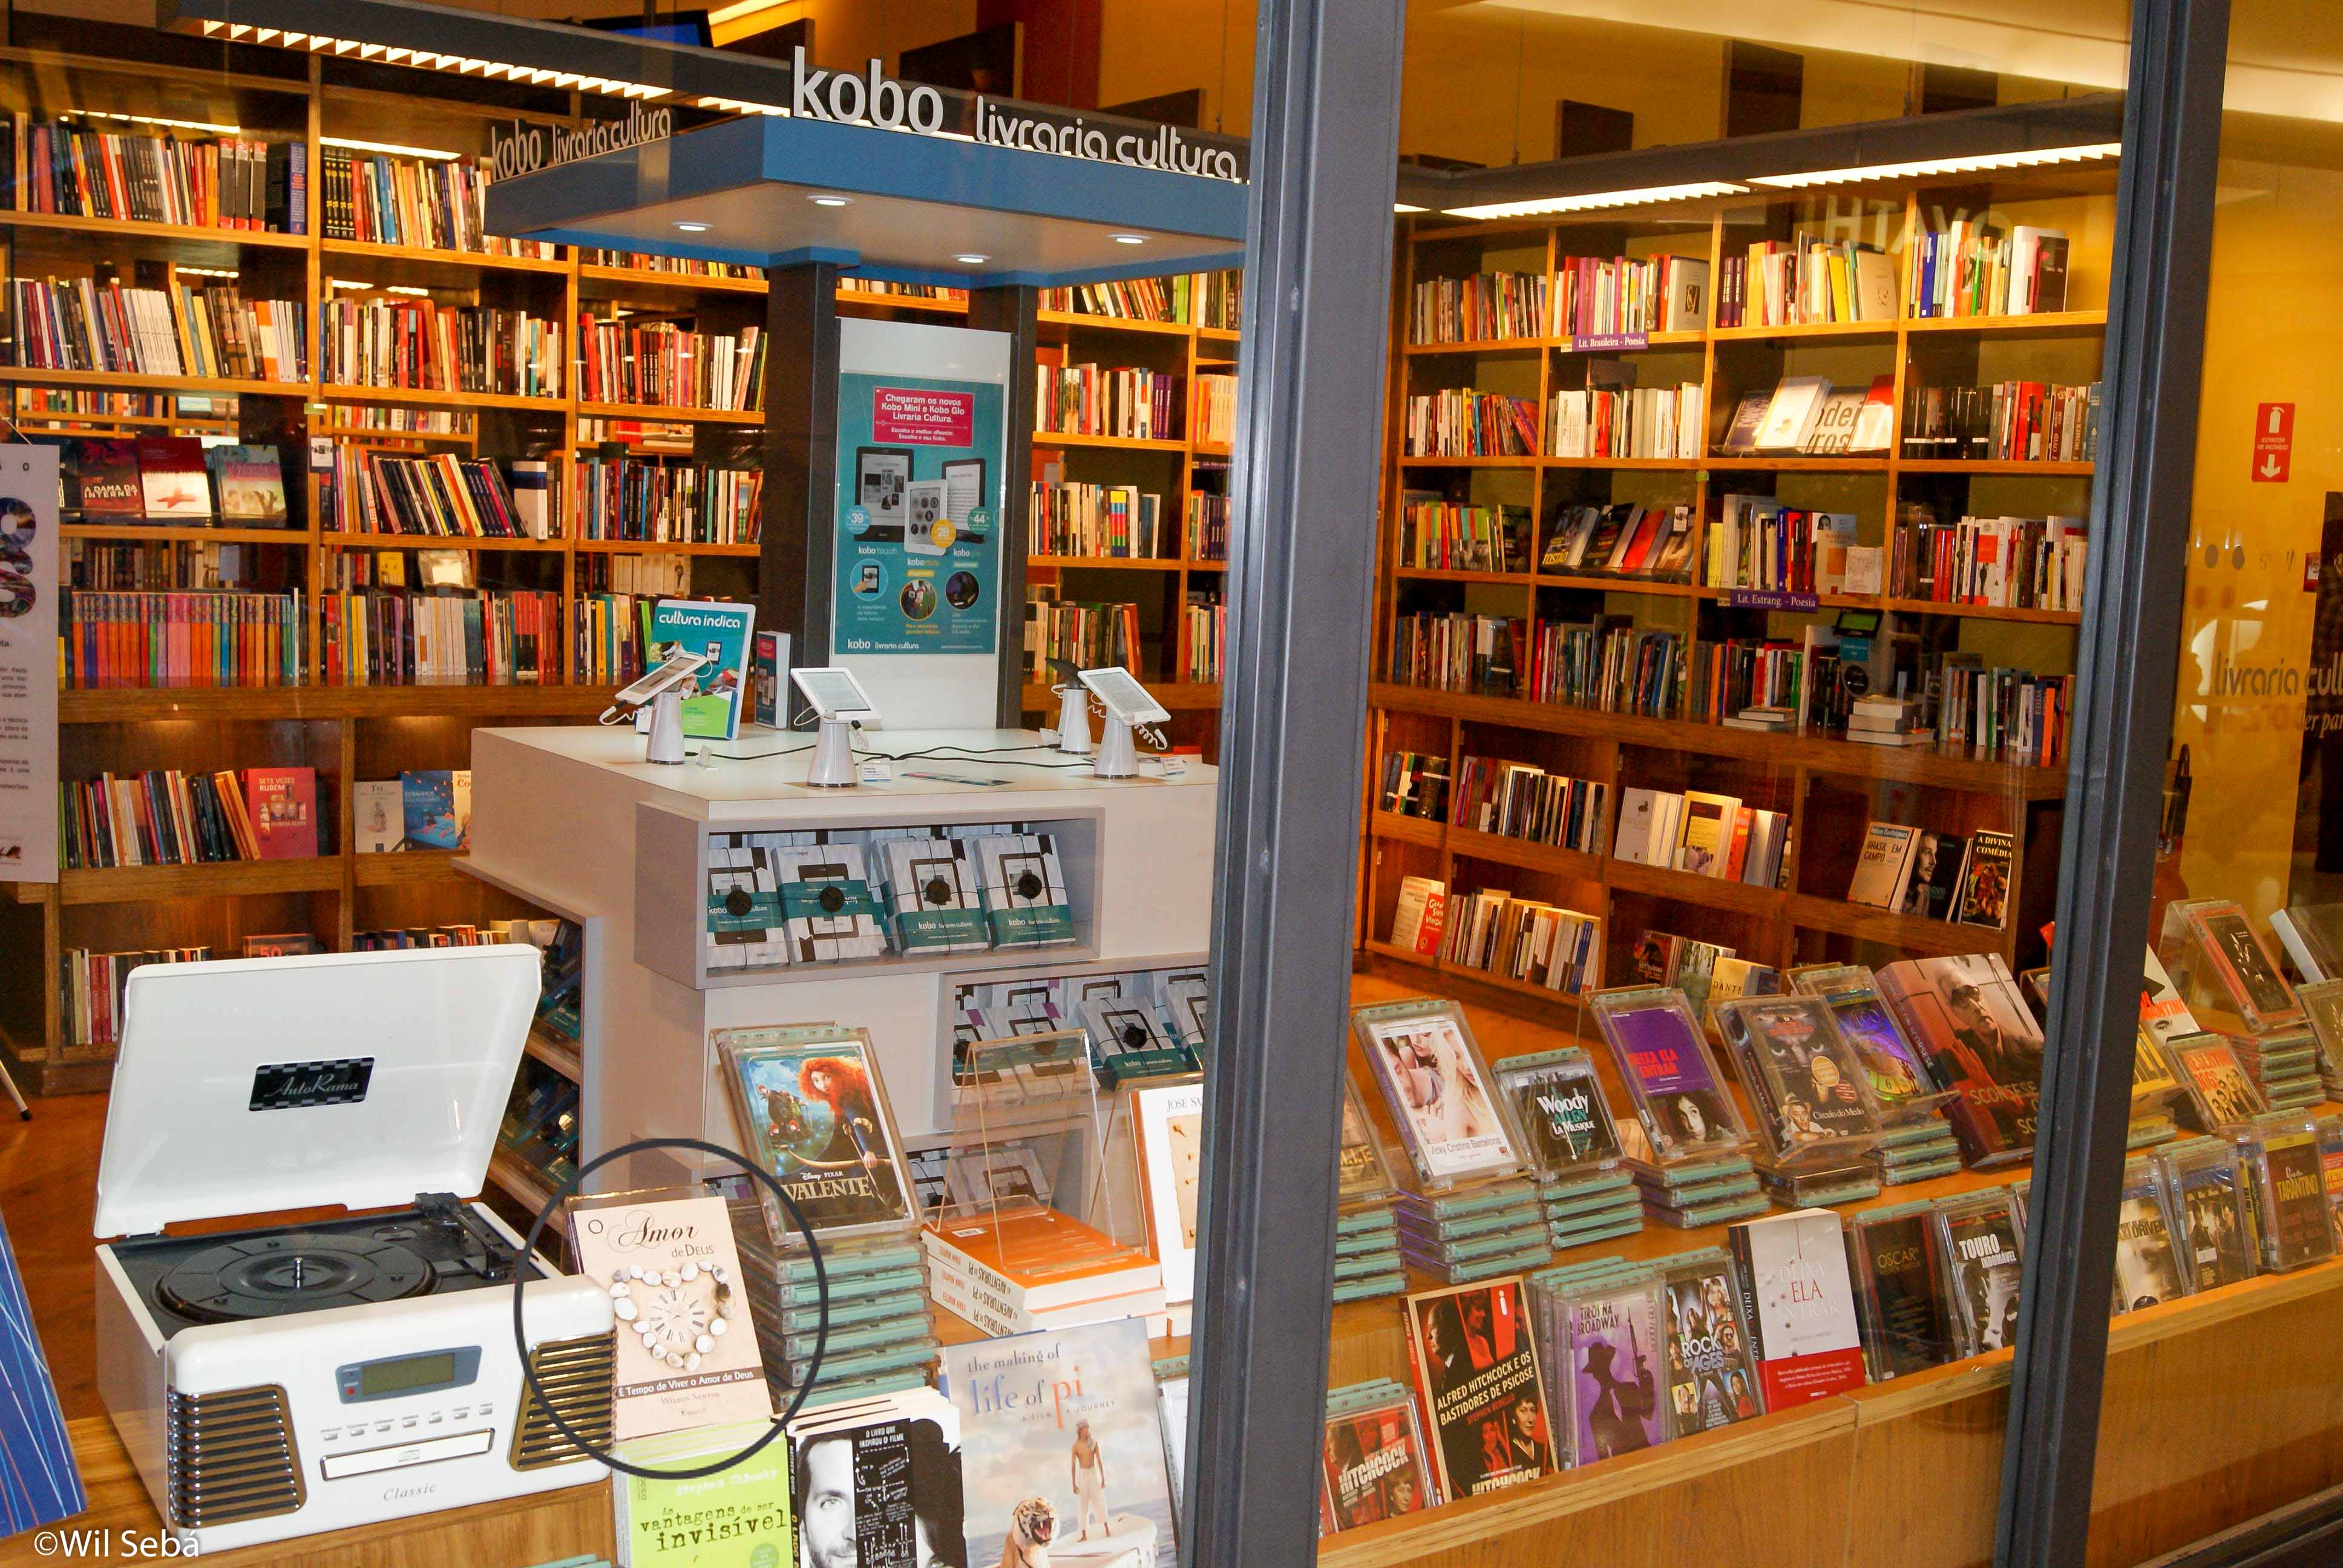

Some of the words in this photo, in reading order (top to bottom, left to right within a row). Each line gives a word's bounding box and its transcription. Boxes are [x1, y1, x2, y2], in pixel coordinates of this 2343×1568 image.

[794, 45, 943, 135] kobo
[977, 95, 1107, 160] livraria
[1116, 125, 1237, 178] cultura
[492, 119, 541, 181] kobo
[552, 119, 606, 164] livraria
[611, 100, 670, 149] cultura
[1578, 338, 1589, 347] Lit.
[1590, 337, 1619, 347] Brasileira
[1624, 336, 1645, 346] Poesia
[885, 394, 925, 404] Chegaram
[882, 402, 902, 411] Kobo
[904, 403, 920, 412] Mini
[929, 405, 949, 414] Kobo
[951, 406, 965, 415] Glo
[893, 412, 921, 421] Livraria
[923, 413, 954, 423] Cultura.
[84, 489, 139, 498] INTERNET
[93, 485, 122, 493] DAMA
[851, 513, 864, 523] 39
[973, 515, 985, 524] 44
[938, 528, 949, 536] 28
[1738, 594, 1750, 604] Lit.
[1752, 595, 1783, 607] Estrang.
[1791, 596, 1815, 607] Poesia
[659, 610, 701, 626] cultura
[703, 615, 741, 629] indica
[848, 639, 871, 649] kobo
[2215, 650, 2298, 696] livraria
[1867, 841, 1887, 852] BRASIL
[1985, 837, 2012, 848] DIVINA
[1863, 851, 1886, 863] CAMPO
[1976, 845, 2013, 858] COMÉDIA
[709, 906, 727, 914] kobo
[918, 921, 937, 930] kobo
[1712, 981, 1743, 996] DANTE
[1123, 1059, 1141, 1067] kobo
[1660, 1048, 1679, 1062] ELA
[263, 1074, 359, 1097] AutoRama
[1970, 1080, 2038, 1105] SCORSESE
[1165, 1097, 1188, 1111] JOSÉ
[1537, 1088, 1588, 1115] Woody
[1554, 1111, 1587, 1124] ALLEN
[1845, 1106, 1864, 1117] Medo
[800, 1172, 822, 1181] Disney
[824, 1170, 844, 1179] PIXAR
[782, 1175, 874, 1203] VALENTE
[2276, 1174, 2319, 1202] TARANTINO
[588, 1219, 604, 1234] O
[607, 1209, 701, 1253] Amor
[672, 1247, 684, 1258] de
[685, 1244, 714, 1257] DEUS
[1959, 1233, 2000, 1261] TOURO
[1878, 1248, 1916, 1269] OSCAR
[1981, 1250, 2017, 1269] INDOMÁVEL
[968, 1261, 974, 1275] PI
[978, 1267, 1007, 1295] AVENTURAS
[972, 1285, 979, 1301] PI
[1791, 1279, 1823, 1302] ELA
[983, 1292, 1014, 1319] AVENTURAS
[1580, 1306, 1601, 1320] TIROS
[1602, 1303, 1613, 1315] NA
[1743, 1292, 1754, 1321] DEIXA
[974, 1308, 979, 1322] PI
[1682, 1336, 1721, 1359] ROCK
[968, 1357, 990, 1373] the
[994, 1348, 1044, 1368] making
[1047, 1342, 1061, 1359] of
[1693, 1352, 1725, 1373] AGES
[618, 1385, 624, 1397] É
[626, 1384, 655, 1396] Tempo
[657, 1382, 667, 1391] de
[667, 1379, 689, 1390] Viver
[698, 1374, 721, 1386] Amor
[723, 1373, 733, 1383] de
[734, 1370, 754, 1380] Deus
[1437, 1385, 1467, 1410] ALFRED
[1469, 1363, 1513, 1393] HITCHCOCK
[1513, 1358, 1520, 1369] E
[1521, 1351, 1531, 1365] OS
[971, 1374, 1018, 1415] life
[1026, 1379, 1045, 1406] of
[1052, 1365, 1084, 1428] pi
[1440, 1393, 1489, 1426] BASTIDORES
[1490, 1386, 1501, 1399] DE
[1502, 1367, 1535, 1394] PSICOSE
[1030, 1412, 1052, 1421] FILM
[1075, 1399, 1116, 1414] JOURNEY
[1466, 1405, 1491, 1425] STEPHEN
[859, 1436, 882, 1448] INSPIROU
[883, 1436, 889, 1445] O
[889, 1432, 905, 1443] FILME
[865, 1429, 870, 1439] O
[871, 1426, 885, 1437] LIVRO
[885, 1425, 896, 1434] QUE
[1339, 1443, 1409, 1494] HITCHCOCK
[383, 1483, 437, 1501] Classic
[675, 1478, 726, 1496] Stephen
[640, 1506, 735, 1532] vantagens
[741, 1506, 752, 1514] de
[757, 1501, 774, 1511] ser
[656, 1509, 787, 1552] invisível
